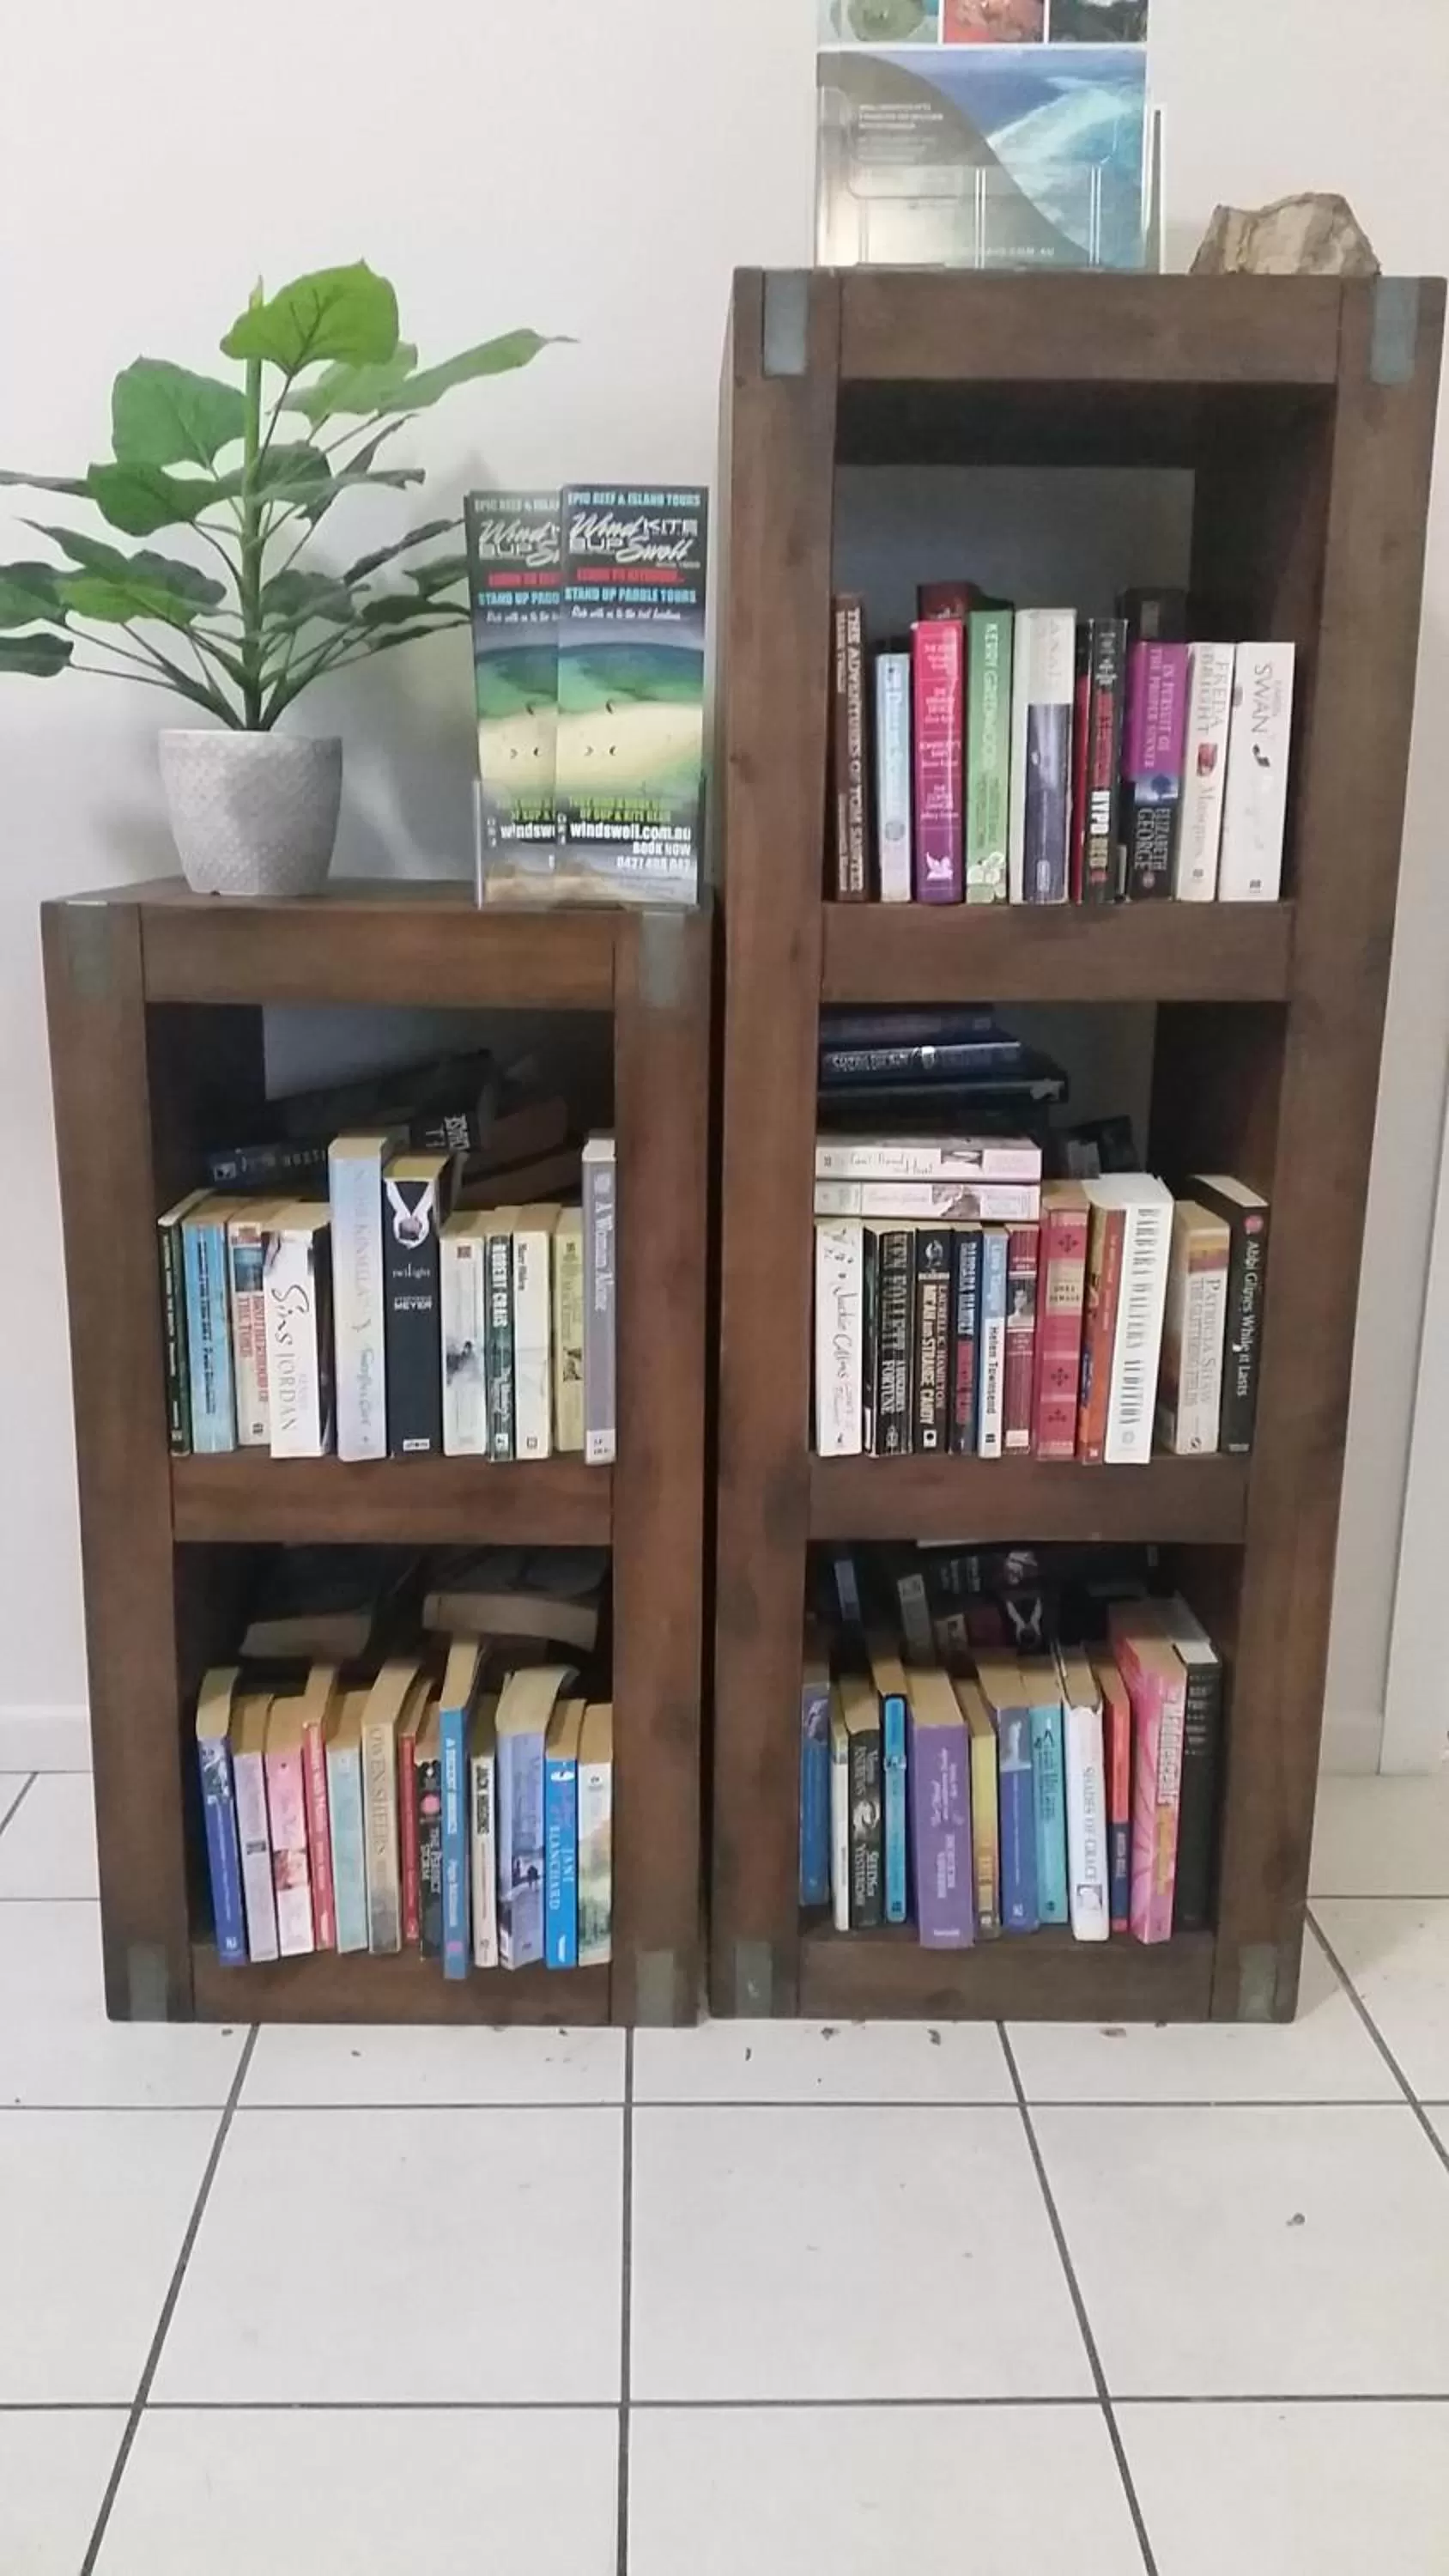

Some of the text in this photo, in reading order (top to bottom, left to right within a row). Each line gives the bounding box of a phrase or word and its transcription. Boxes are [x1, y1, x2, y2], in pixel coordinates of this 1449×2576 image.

[602, 587, 617, 602] UP
[847, 606, 862, 643] THE
[847, 647, 863, 758] ADVENTURES
[1146, 673, 1162, 720] PROPER
[1159, 683, 1173, 732] PURSUIT
[1251, 664, 1273, 733] SWAN
[1143, 725, 1159, 769] SINNER
[849, 786, 864, 823] TOM
[570, 822, 691, 841] windswell.com.au
[1134, 808, 1155, 870] GEORGE
[1153, 808, 1171, 871] ELIZABETH
[850, 827, 864, 891] SAWYER
[492, 1242, 508, 1288] ROBERT
[596, 1216, 613, 1267] Woman
[1131, 1208, 1161, 1276] BARBARA
[1244, 1240, 1259, 1270] Abbi
[270, 1284, 309, 1346] Sins
[595, 1272, 613, 1310] Alone
[882, 1233, 907, 1351] KEN FOLLETT
[986, 1326, 999, 1359] Helen
[1240, 1315, 1255, 1352] While
[919, 1338, 937, 1387] STRANGE
[1236, 1365, 1252, 1396] Lasts
[275, 1352, 297, 1431] JORDAN
[880, 1360, 896, 1415] FORTUNE
[919, 1389, 936, 1425] CANDY
[985, 1361, 998, 1414] Townsend
[1119, 1359, 1145, 1425] AUDITION
[369, 1728, 386, 1783] OWEN
[476, 1765, 489, 1792] JACK
[548, 1826, 561, 1911] BLANCHARD
